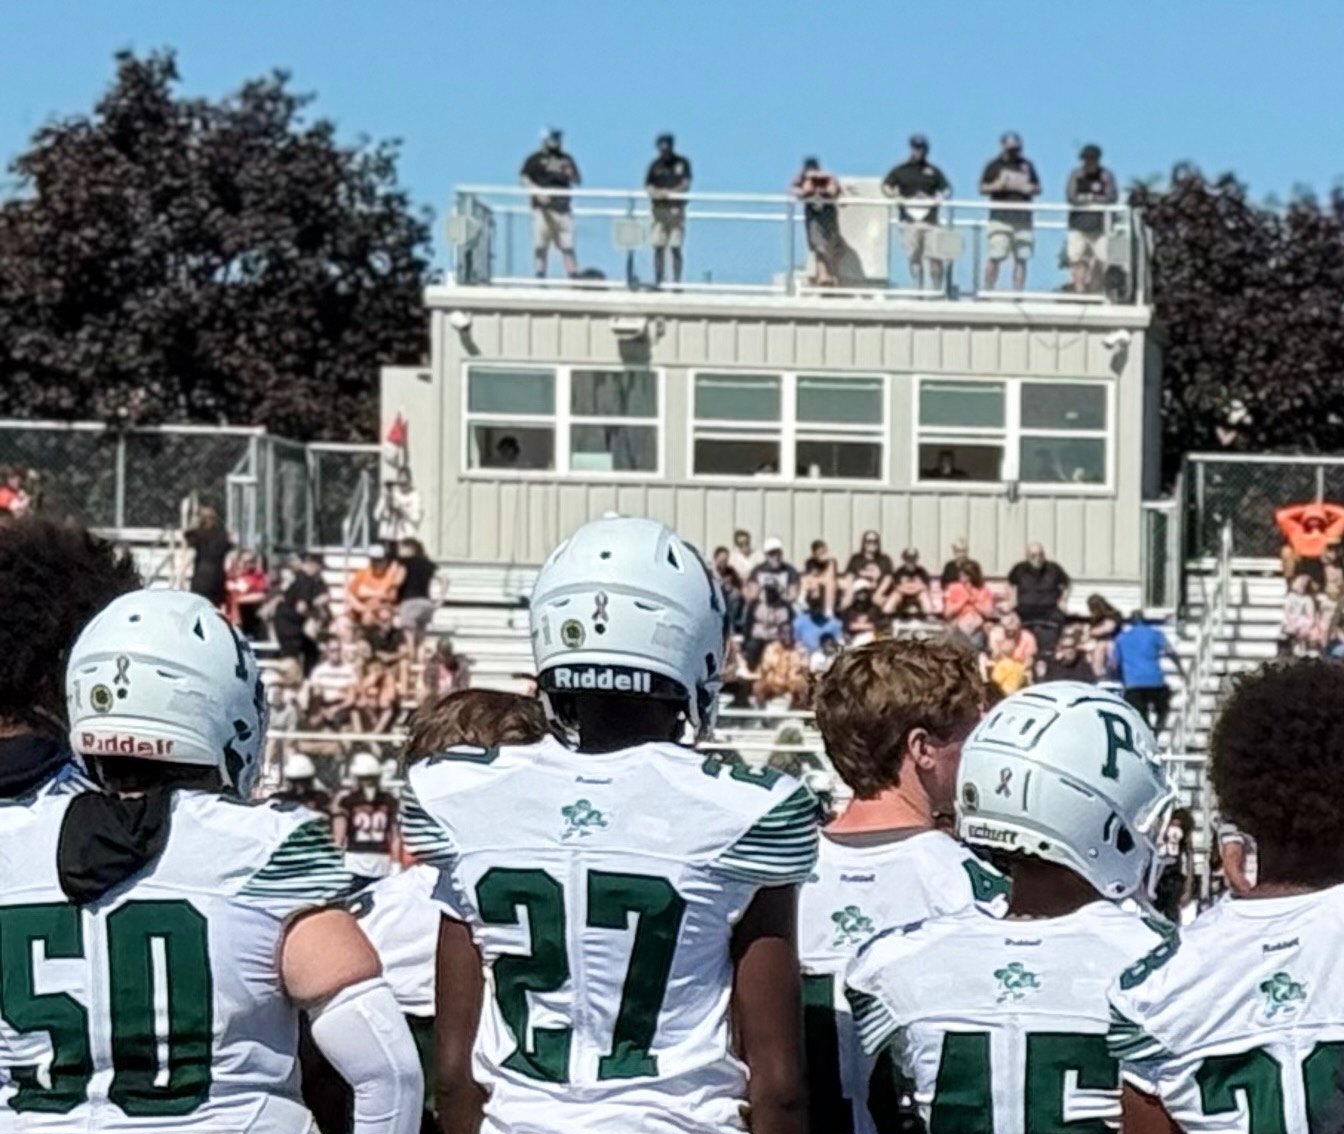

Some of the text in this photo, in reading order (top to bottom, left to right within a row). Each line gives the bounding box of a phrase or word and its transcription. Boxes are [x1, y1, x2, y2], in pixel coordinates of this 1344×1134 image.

[554, 667, 651, 693] Riddell
[1096, 709, 1137, 780] P
[0, 900, 212, 1117] 50
[474, 867, 687, 1085] 27
